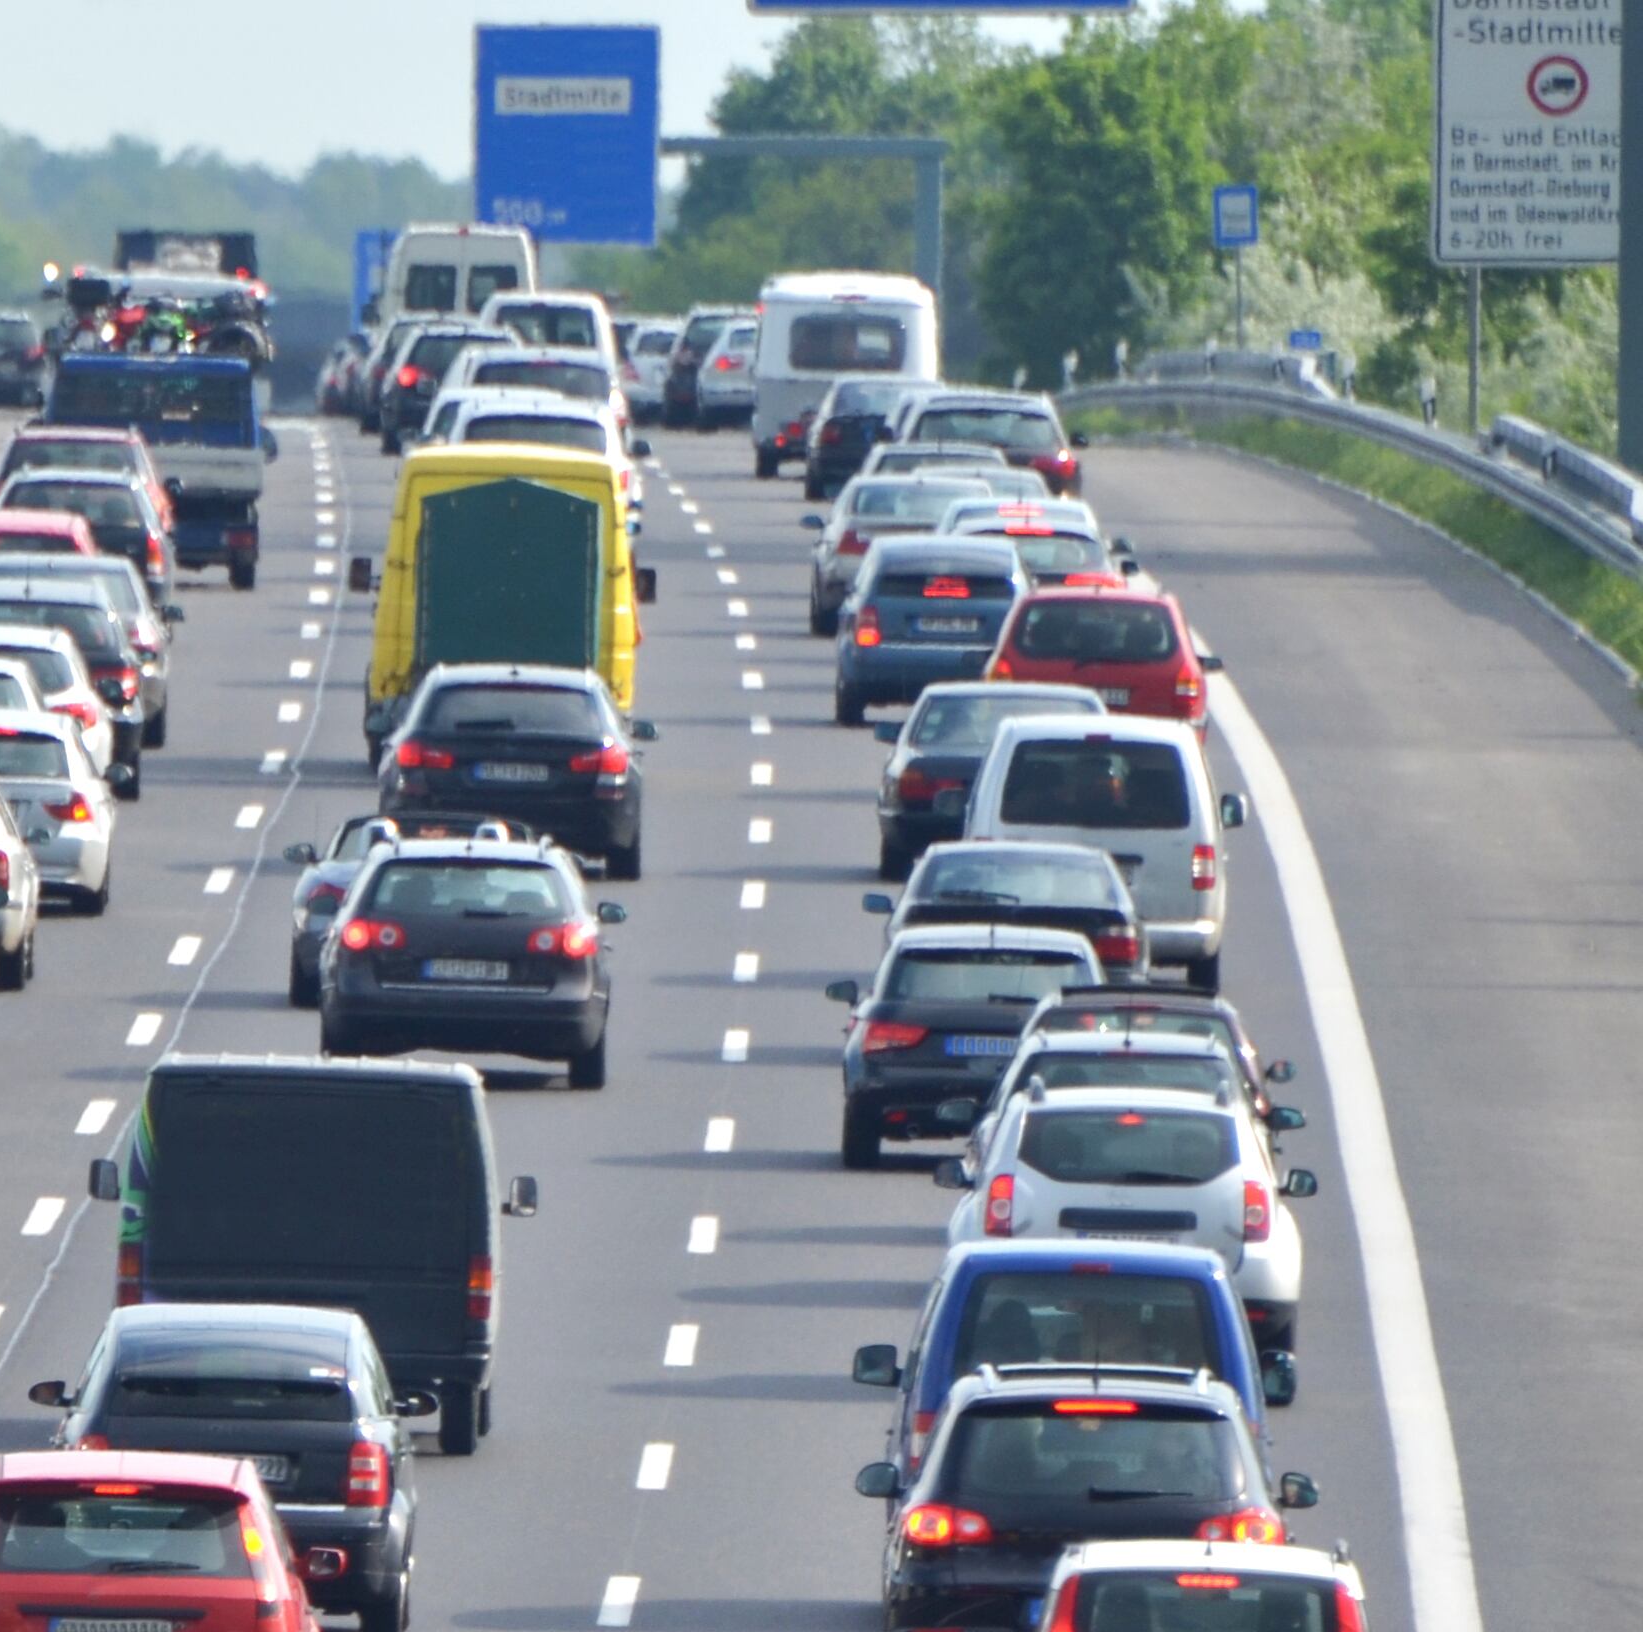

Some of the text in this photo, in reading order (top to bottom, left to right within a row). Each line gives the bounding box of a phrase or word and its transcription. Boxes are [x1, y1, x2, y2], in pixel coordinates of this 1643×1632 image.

[503, 86, 623, 108] Stadtmitte
[1450, 127, 1491, 147] Be-
[1502, 127, 1543, 147] und
[1450, 152, 1466, 172] in
[1571, 153, 1592, 172] im
[1450, 177, 1611, 203] Darmstadt-Dieburg
[1450, 204, 1481, 223] und
[1488, 204, 1507, 223] im
[1524, 229, 1563, 249] frei
